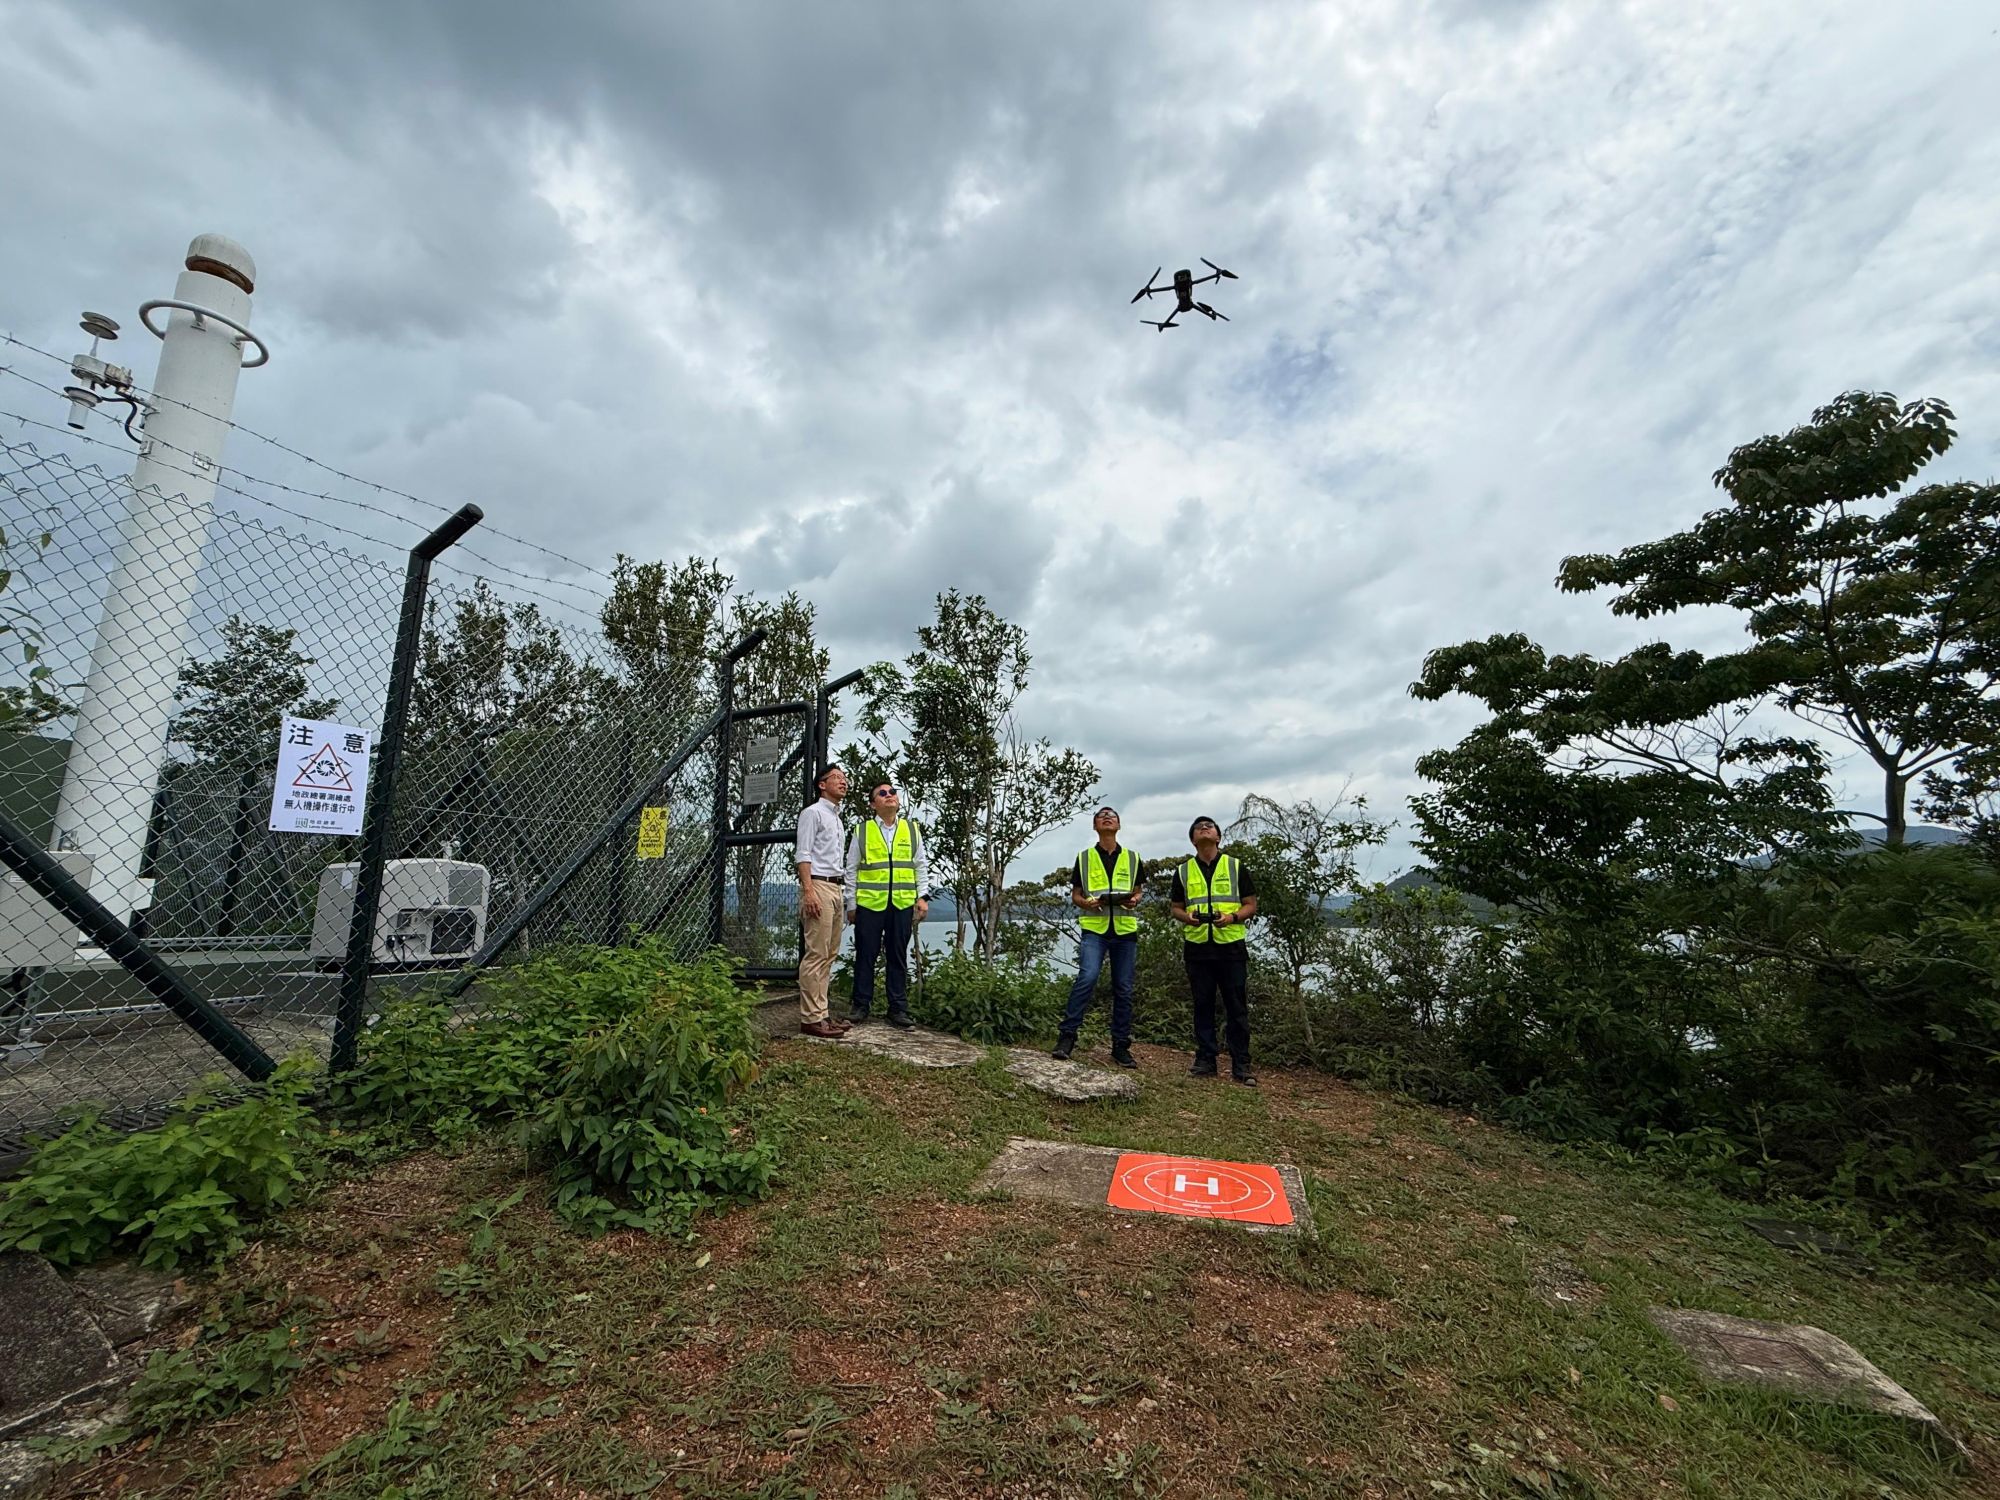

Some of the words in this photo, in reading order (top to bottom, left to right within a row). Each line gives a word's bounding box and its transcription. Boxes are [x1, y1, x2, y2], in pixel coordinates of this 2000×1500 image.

[288, 724, 314, 746] 注
[342, 733, 365, 753] 意
[283, 799, 356, 815] 無人機操作進行中
[1174, 1174, 1219, 1196] H
